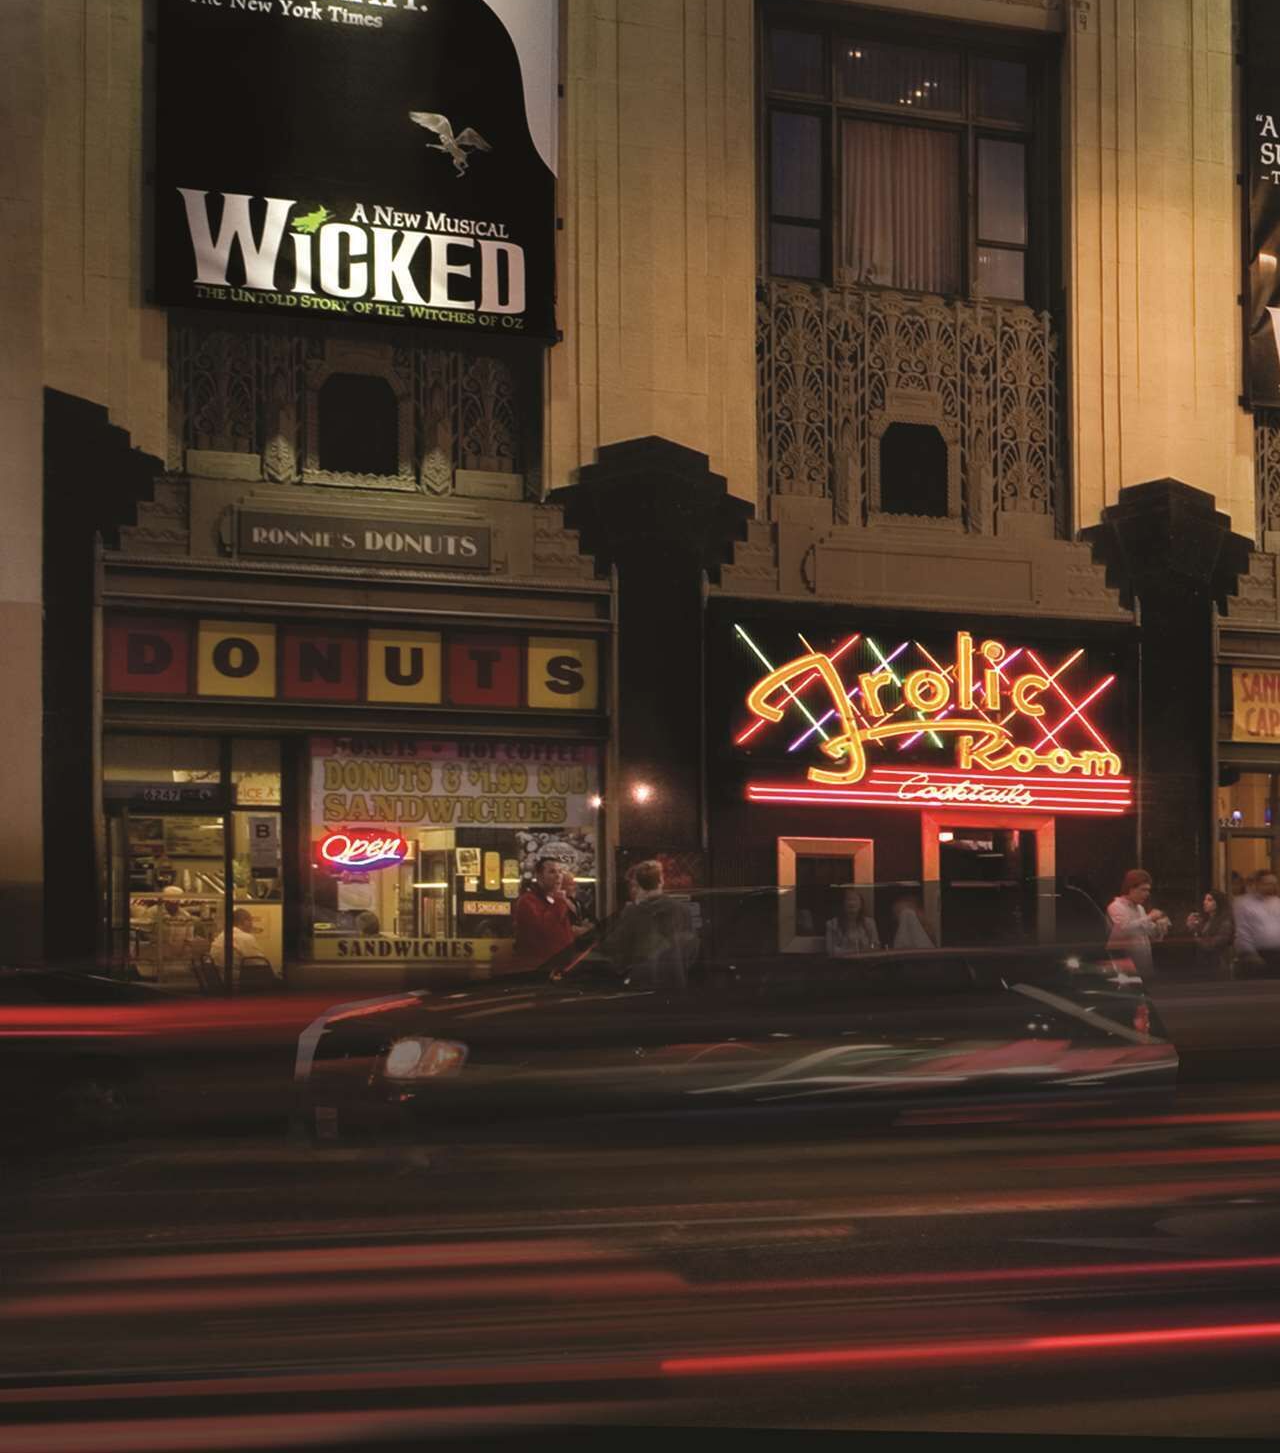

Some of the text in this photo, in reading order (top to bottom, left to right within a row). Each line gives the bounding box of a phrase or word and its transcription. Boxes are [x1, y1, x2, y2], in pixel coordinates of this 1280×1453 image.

[279, 0, 323, 21] York
[328, 6, 383, 28] Times
[1256, 114, 1278, 138] “A
[350, 203, 509, 238] A NEW MUSICAL
[196, 285, 524, 330] THE UNTOLD STORY OF THE WITCHES OF OZ
[252, 527, 478, 557] RONNIE'S DONUTS
[127, 633, 585, 695] DONUTS
[747, 630, 1052, 785] Frolic
[960, 735, 1122, 775] Room
[323, 759, 432, 792] DONUTS
[470, 763, 528, 794] $1.99
[537, 763, 588, 795] SUB
[897, 773, 1035, 806] Cocktails
[323, 792, 567, 824] SANDWICHES
[256, 824, 270, 838] B
[321, 834, 401, 865] Open
[337, 938, 474, 958] SANDWICHES
